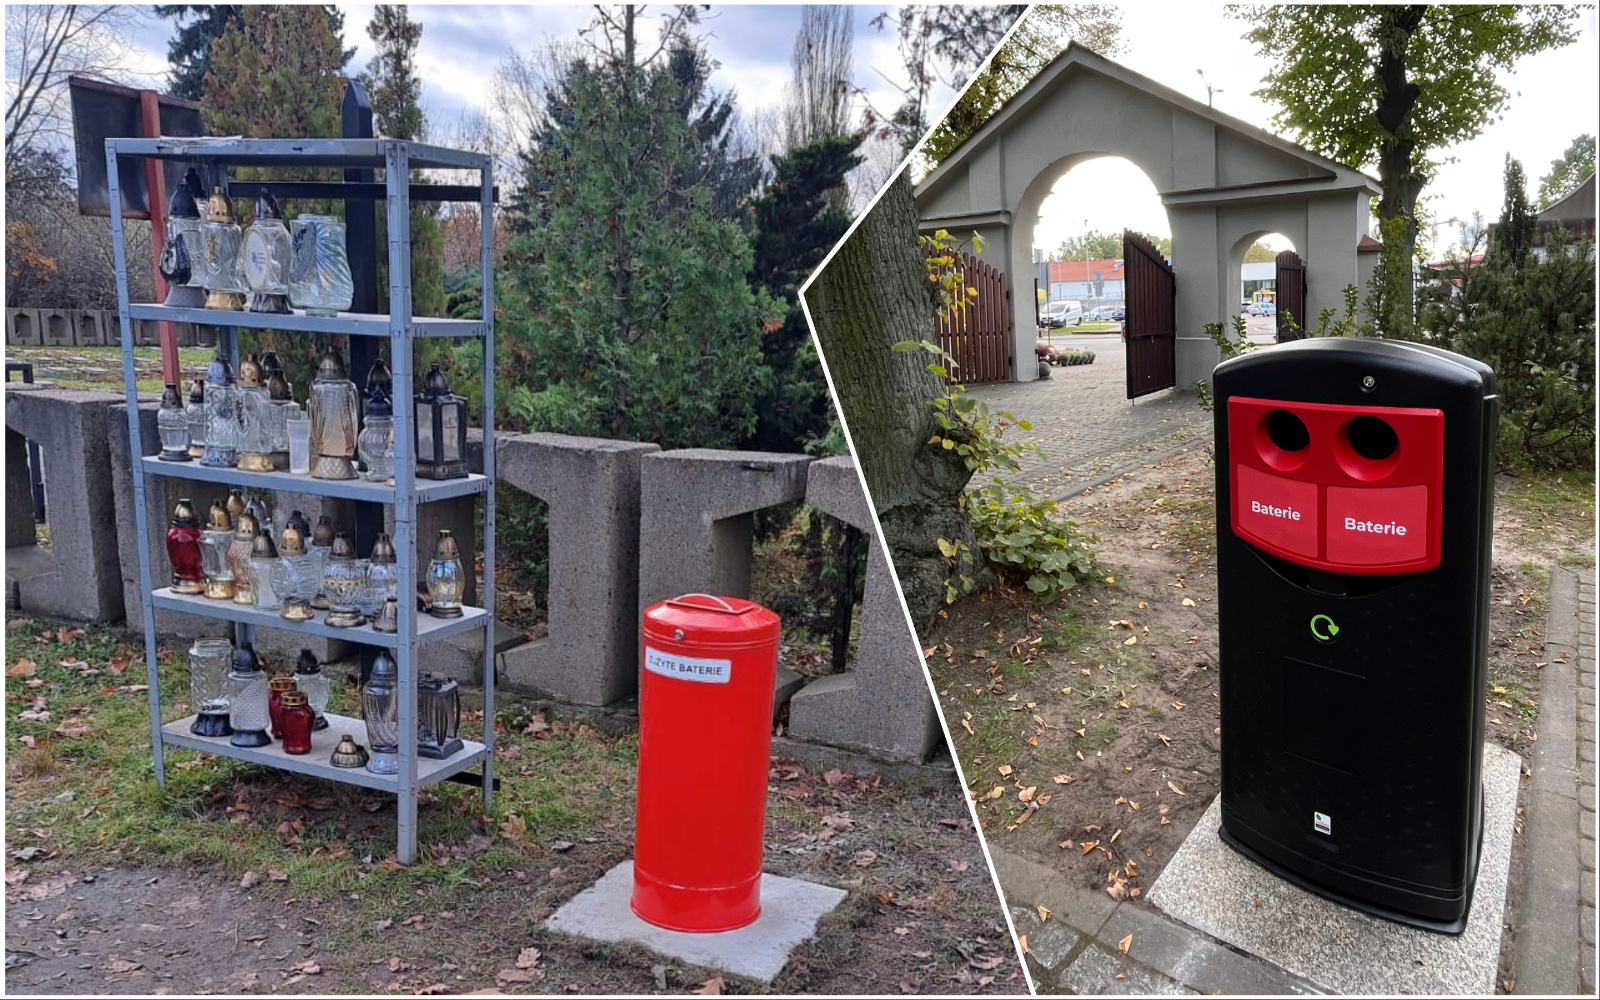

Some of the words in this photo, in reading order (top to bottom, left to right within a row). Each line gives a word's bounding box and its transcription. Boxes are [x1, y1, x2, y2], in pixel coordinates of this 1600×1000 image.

[1251, 500, 1301, 521] Baterie
[1345, 517, 1407, 536] Baterie
[678, 663, 723, 675] BATERIE
